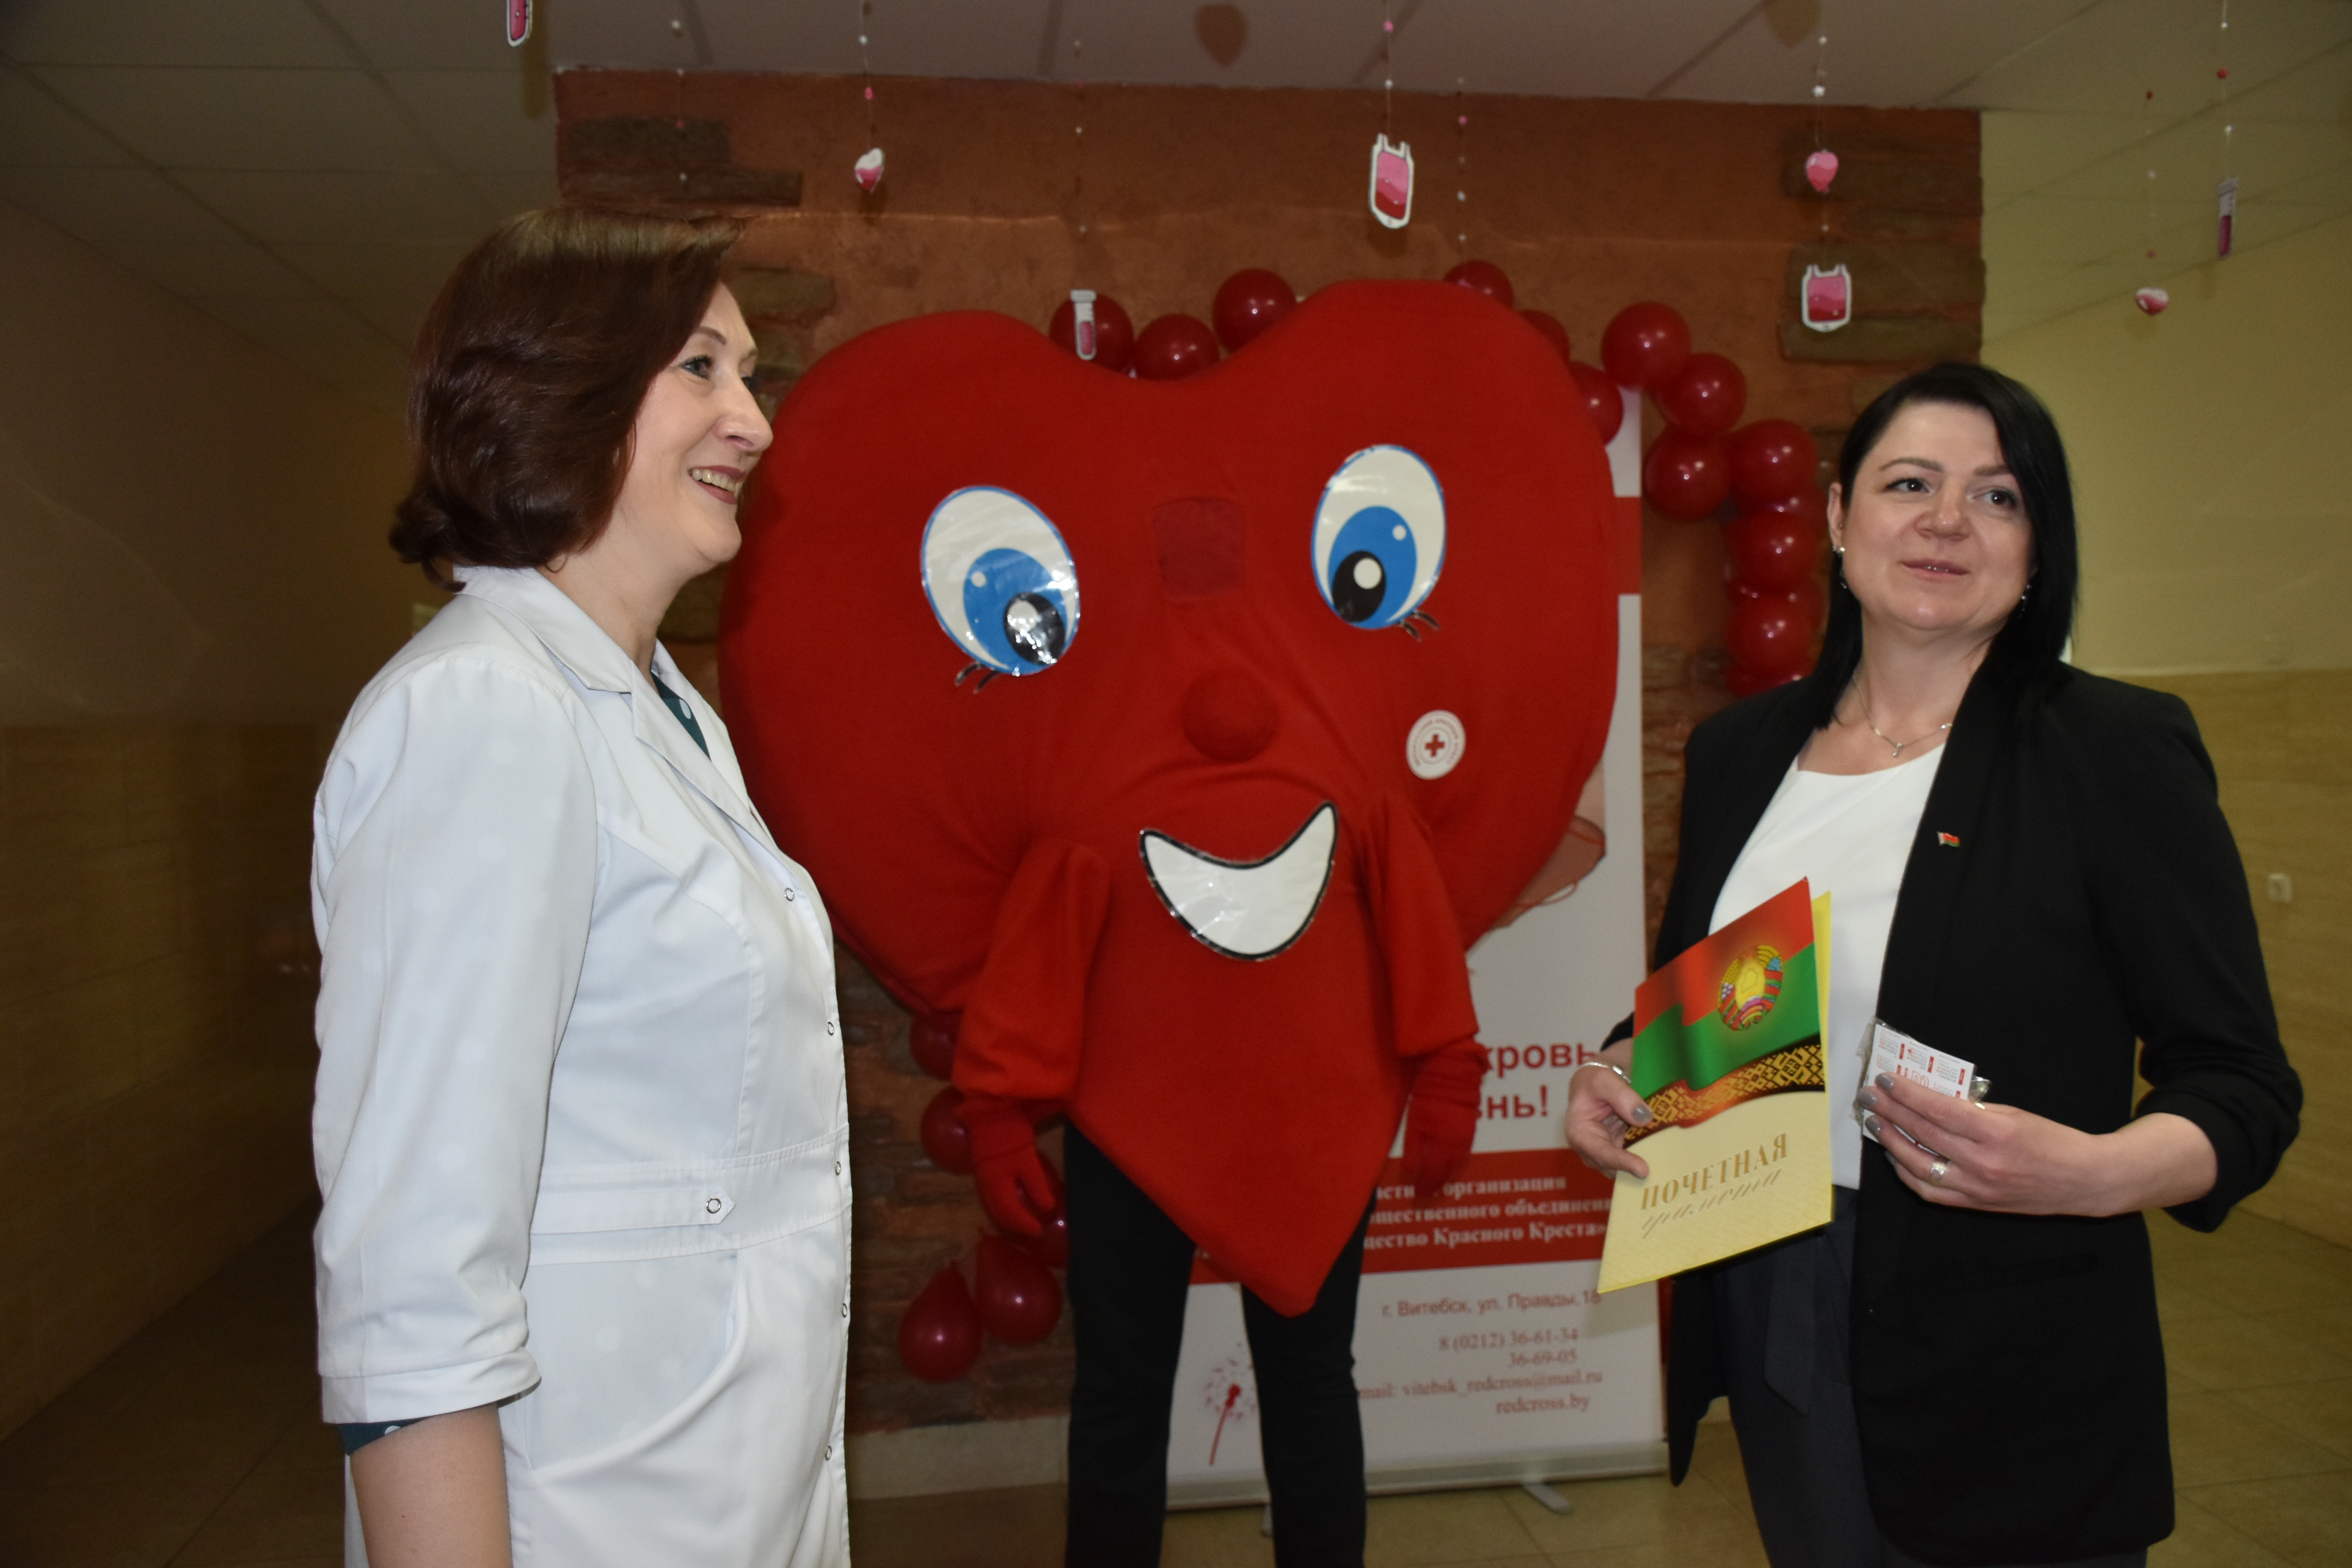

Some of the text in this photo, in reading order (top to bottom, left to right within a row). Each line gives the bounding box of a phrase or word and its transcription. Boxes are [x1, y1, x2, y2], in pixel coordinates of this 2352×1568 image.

[1480, 1084, 1548, 1120] нь!
[1641, 1132, 1788, 1210] ПОЧЕТНАЯ
[1443, 1176, 1566, 1201] организация
[1434, 1226, 1524, 1249] Красного
[1477, 1297, 1501, 1316] ул.
